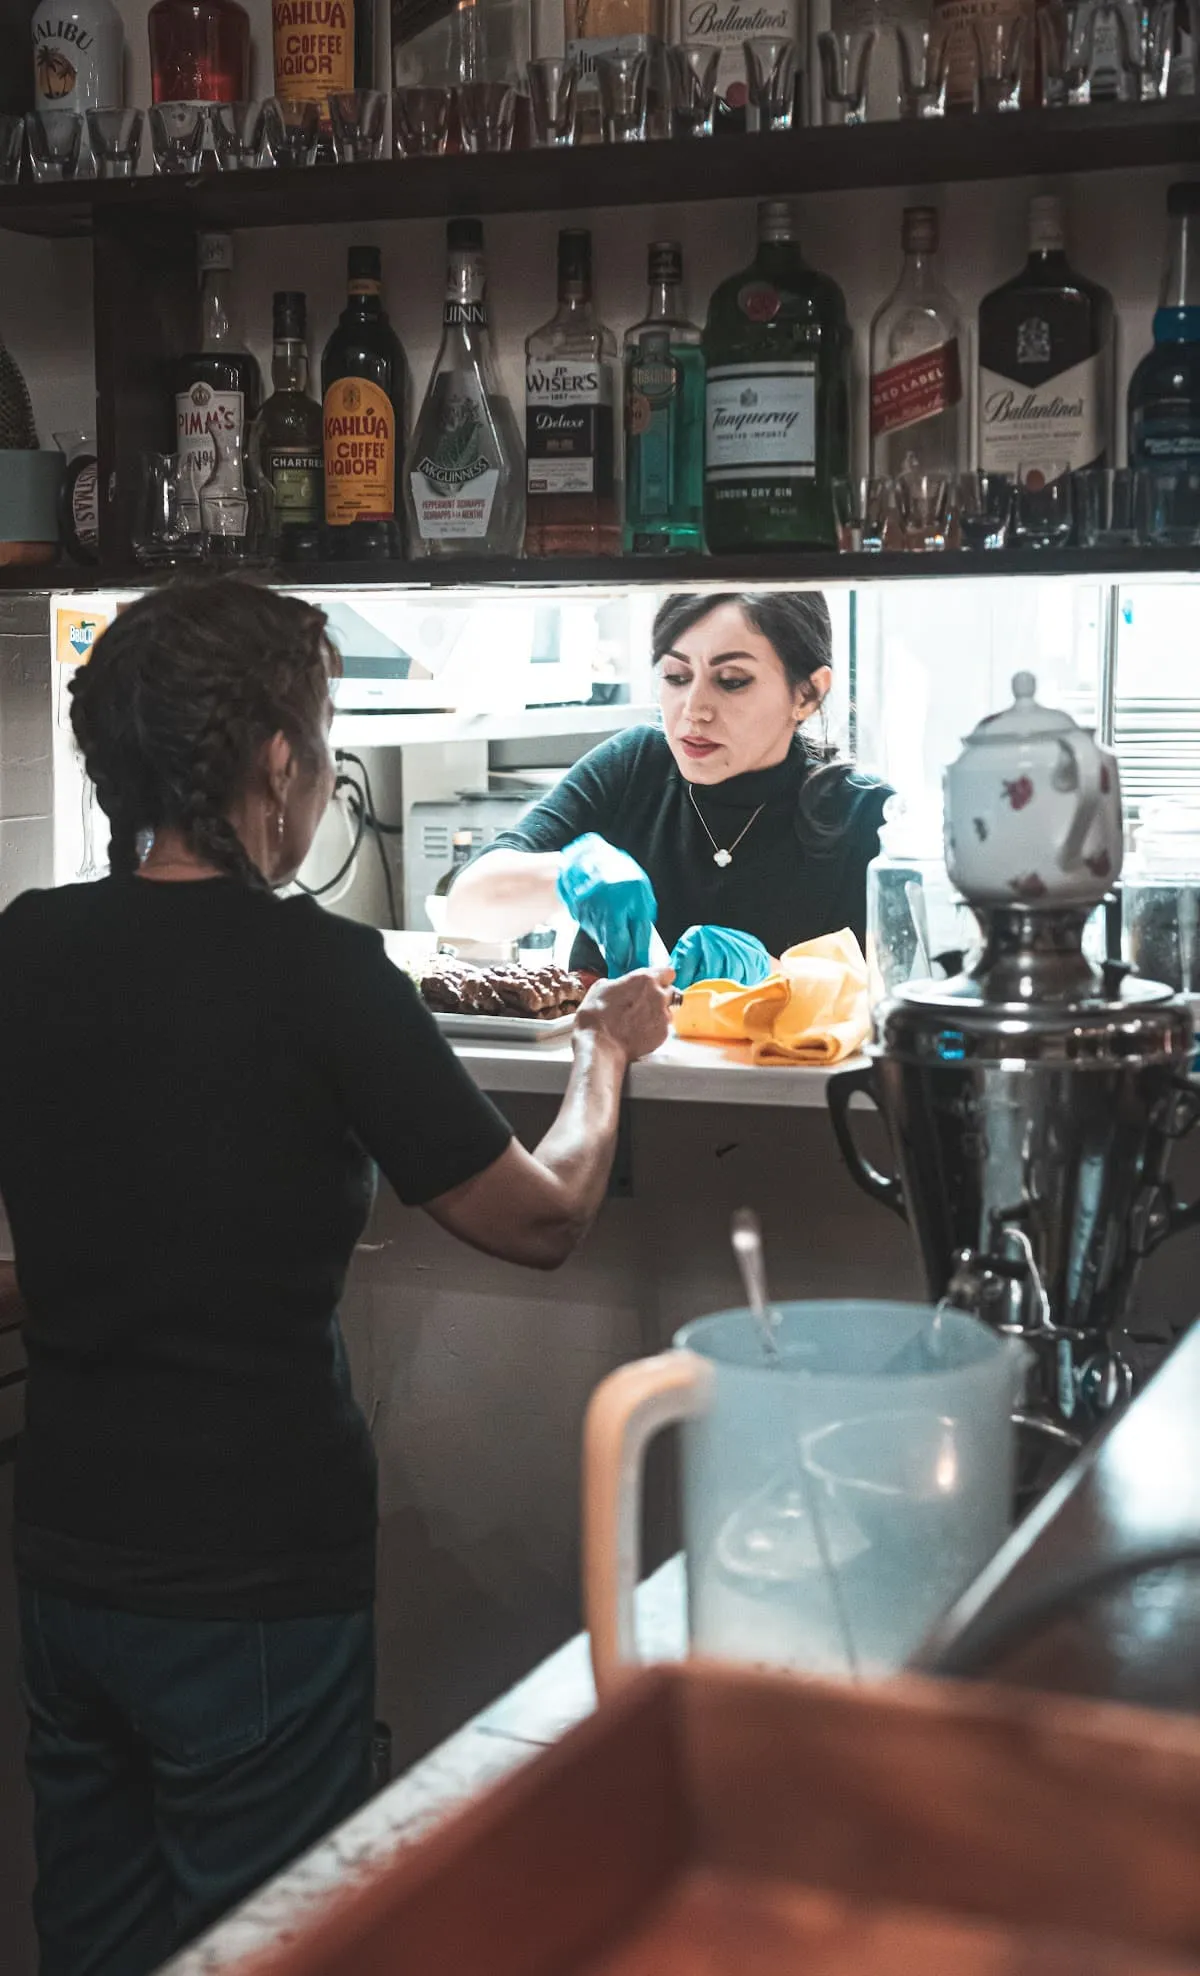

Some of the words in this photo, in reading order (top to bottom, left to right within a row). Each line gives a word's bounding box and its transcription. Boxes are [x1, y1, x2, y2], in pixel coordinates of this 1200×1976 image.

[688, 3, 788, 35] Ballantine's
[286, 34, 342, 55] COFFEE
[526, 369, 598, 392] WISER'S
[872, 386, 899, 409] RED
[901, 367, 944, 393] LABEL
[985, 390, 1083, 423] Ballantine's
[535, 413, 585, 430] Deluxe
[713, 407, 799, 431] Tanqueray
[337, 442, 385, 459] COFFEE
[327, 459, 377, 476] LIQUOR
[775, 487, 792, 497] GIN
